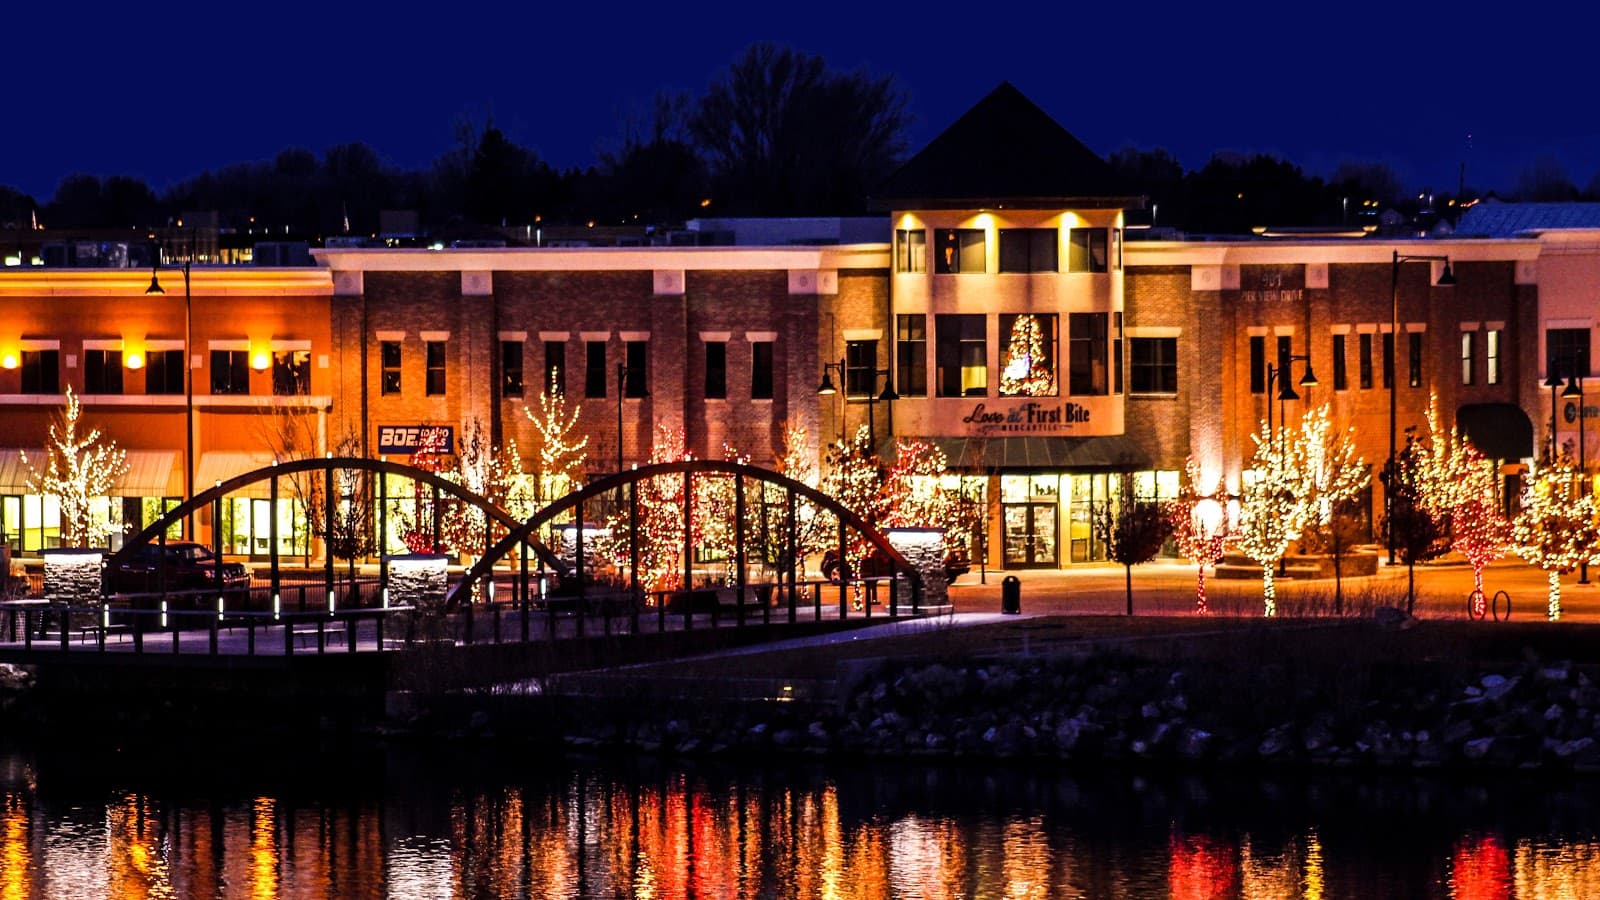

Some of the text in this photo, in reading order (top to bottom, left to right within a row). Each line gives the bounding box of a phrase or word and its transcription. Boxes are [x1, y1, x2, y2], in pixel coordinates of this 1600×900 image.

[1281, 289, 1303, 302] DRIVE
[963, 403, 1004, 424] Love
[1028, 403, 1061, 423] First
[1066, 403, 1090, 423] Bite
